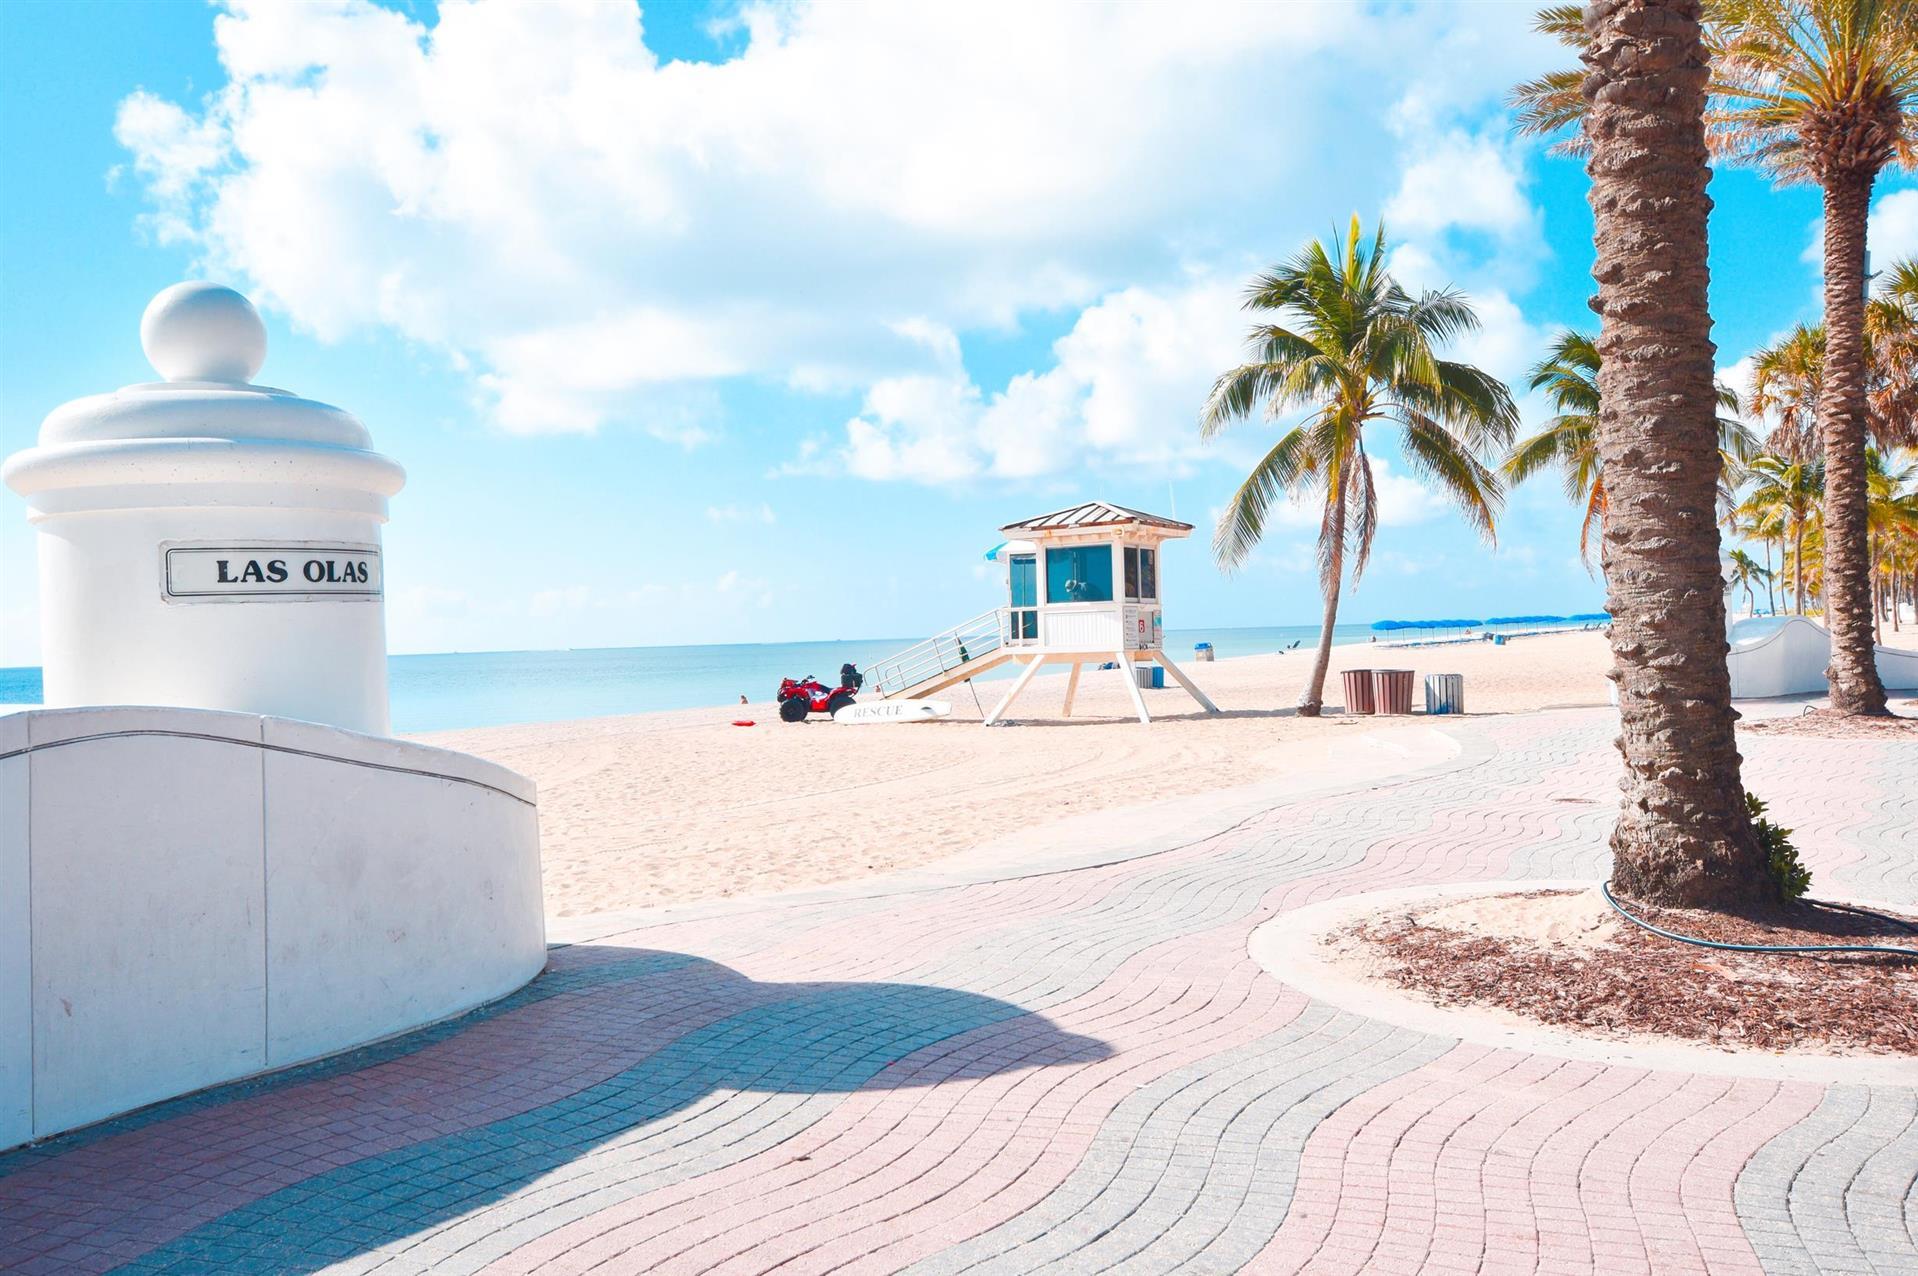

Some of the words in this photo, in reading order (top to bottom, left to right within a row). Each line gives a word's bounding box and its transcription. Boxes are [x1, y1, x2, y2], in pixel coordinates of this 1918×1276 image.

[216, 559, 288, 583] LAS
[303, 559, 368, 584] OLAS
[854, 704, 903, 718] RESCUE
